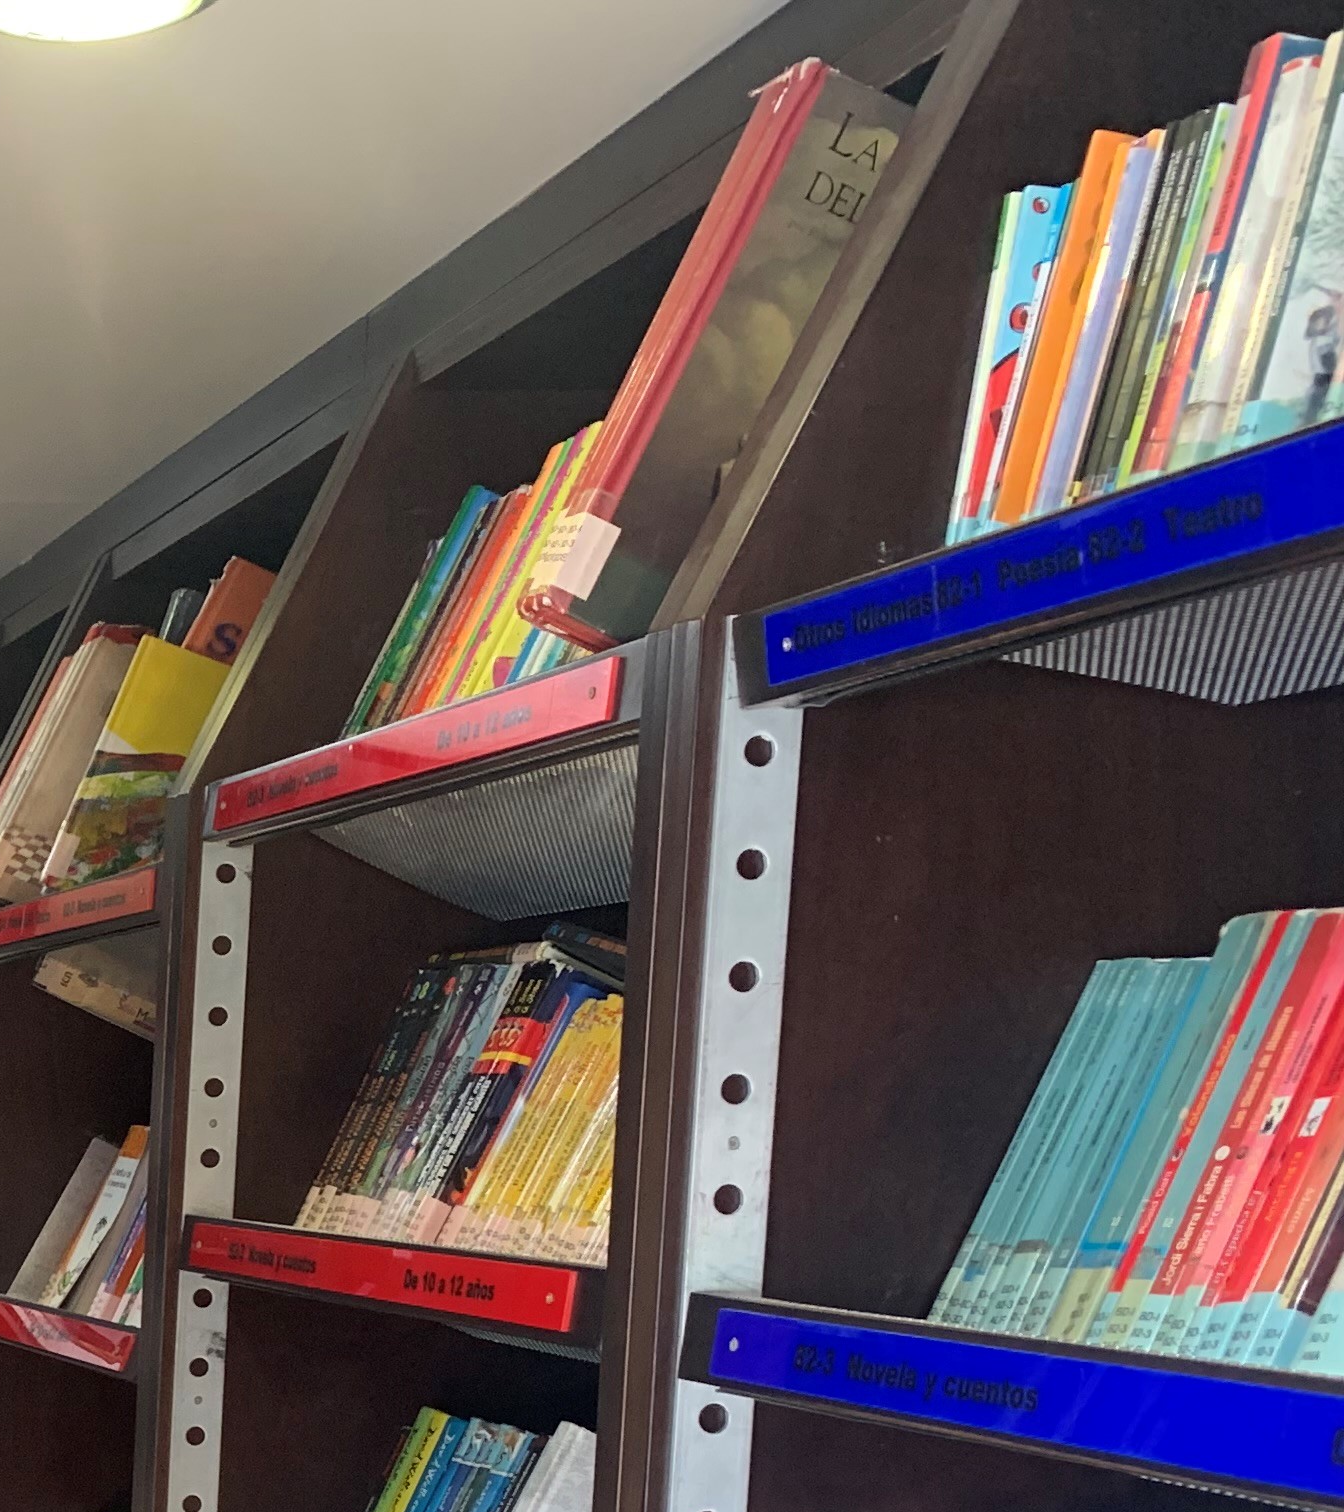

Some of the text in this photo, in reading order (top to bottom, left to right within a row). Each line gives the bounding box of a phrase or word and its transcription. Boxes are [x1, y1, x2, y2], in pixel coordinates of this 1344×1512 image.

[829, 111, 882, 171] LA
[1157, 1250, 1183, 1287] Jordi
[1174, 1210, 1203, 1252] Sierra
[1196, 1162, 1223, 1204] Fabra
[404, 1268, 418, 1290] De
[422, 1271, 436, 1293] 10
[438, 1279, 446, 1294] a
[451, 1275, 464, 1297] 12
[466, 1277, 496, 1302] años
[848, 1352, 918, 1392] Novela
[923, 1366, 937, 1402] y
[943, 1370, 1039, 1412] cuentos
